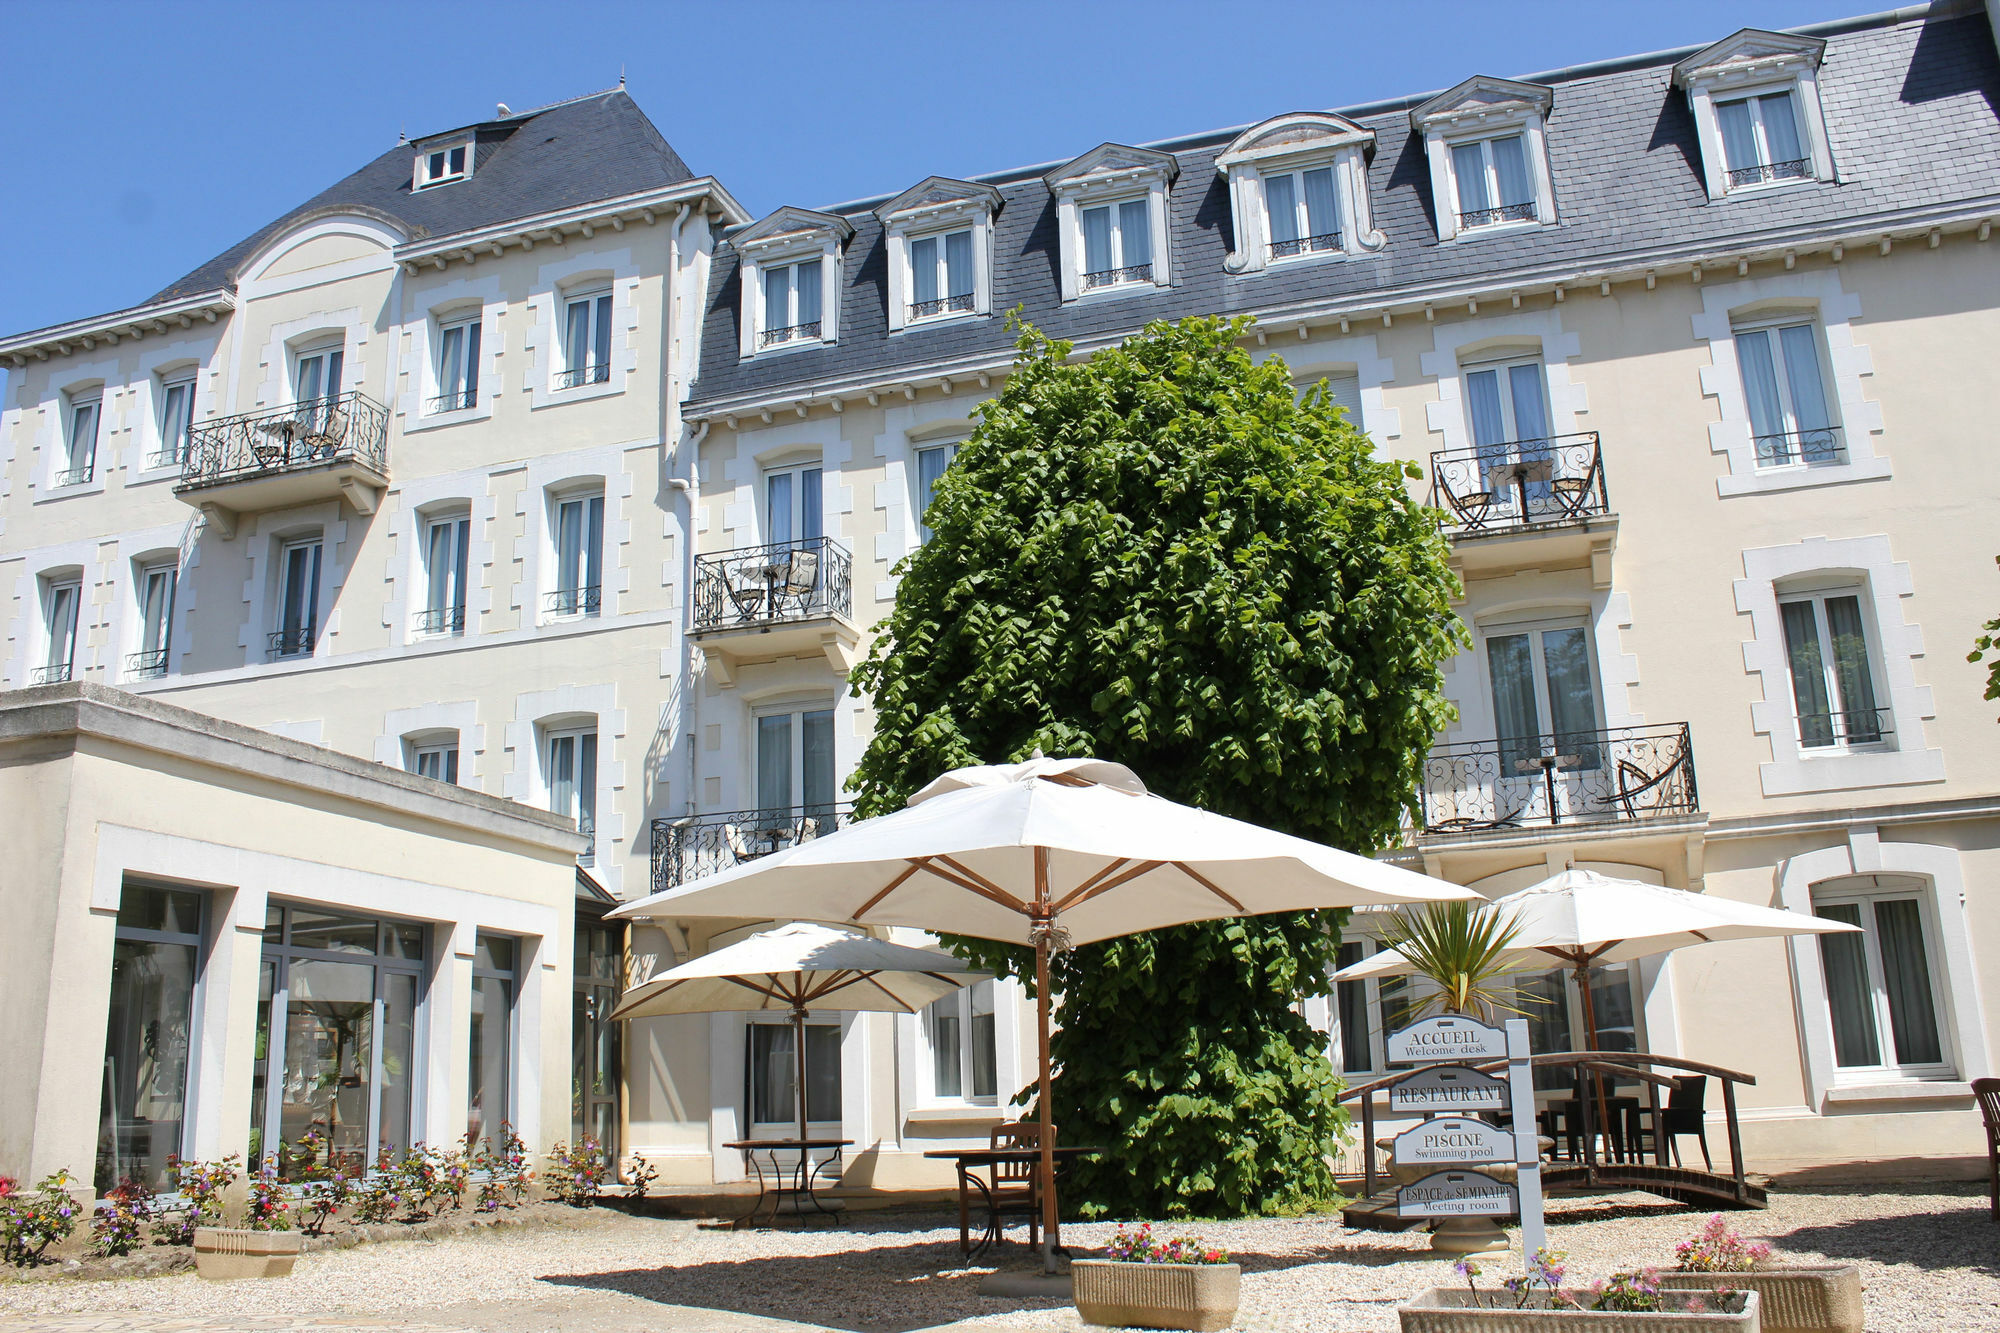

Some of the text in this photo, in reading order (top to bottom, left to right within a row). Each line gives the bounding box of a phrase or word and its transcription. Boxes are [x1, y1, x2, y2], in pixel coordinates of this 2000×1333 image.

[1410, 1031, 1480, 1046] ACCUEIL
[1406, 1044, 1487, 1056] Welcome desk
[1399, 1086, 1505, 1103] RESTAURANT
[1424, 1134, 1483, 1147] PISCINE
[1415, 1147, 1494, 1160] Swimming pool
[1406, 1188, 1442, 1201] ESPACE
[1445, 1191, 1455, 1199] de
[1423, 1202, 1499, 1213] Meeting room
